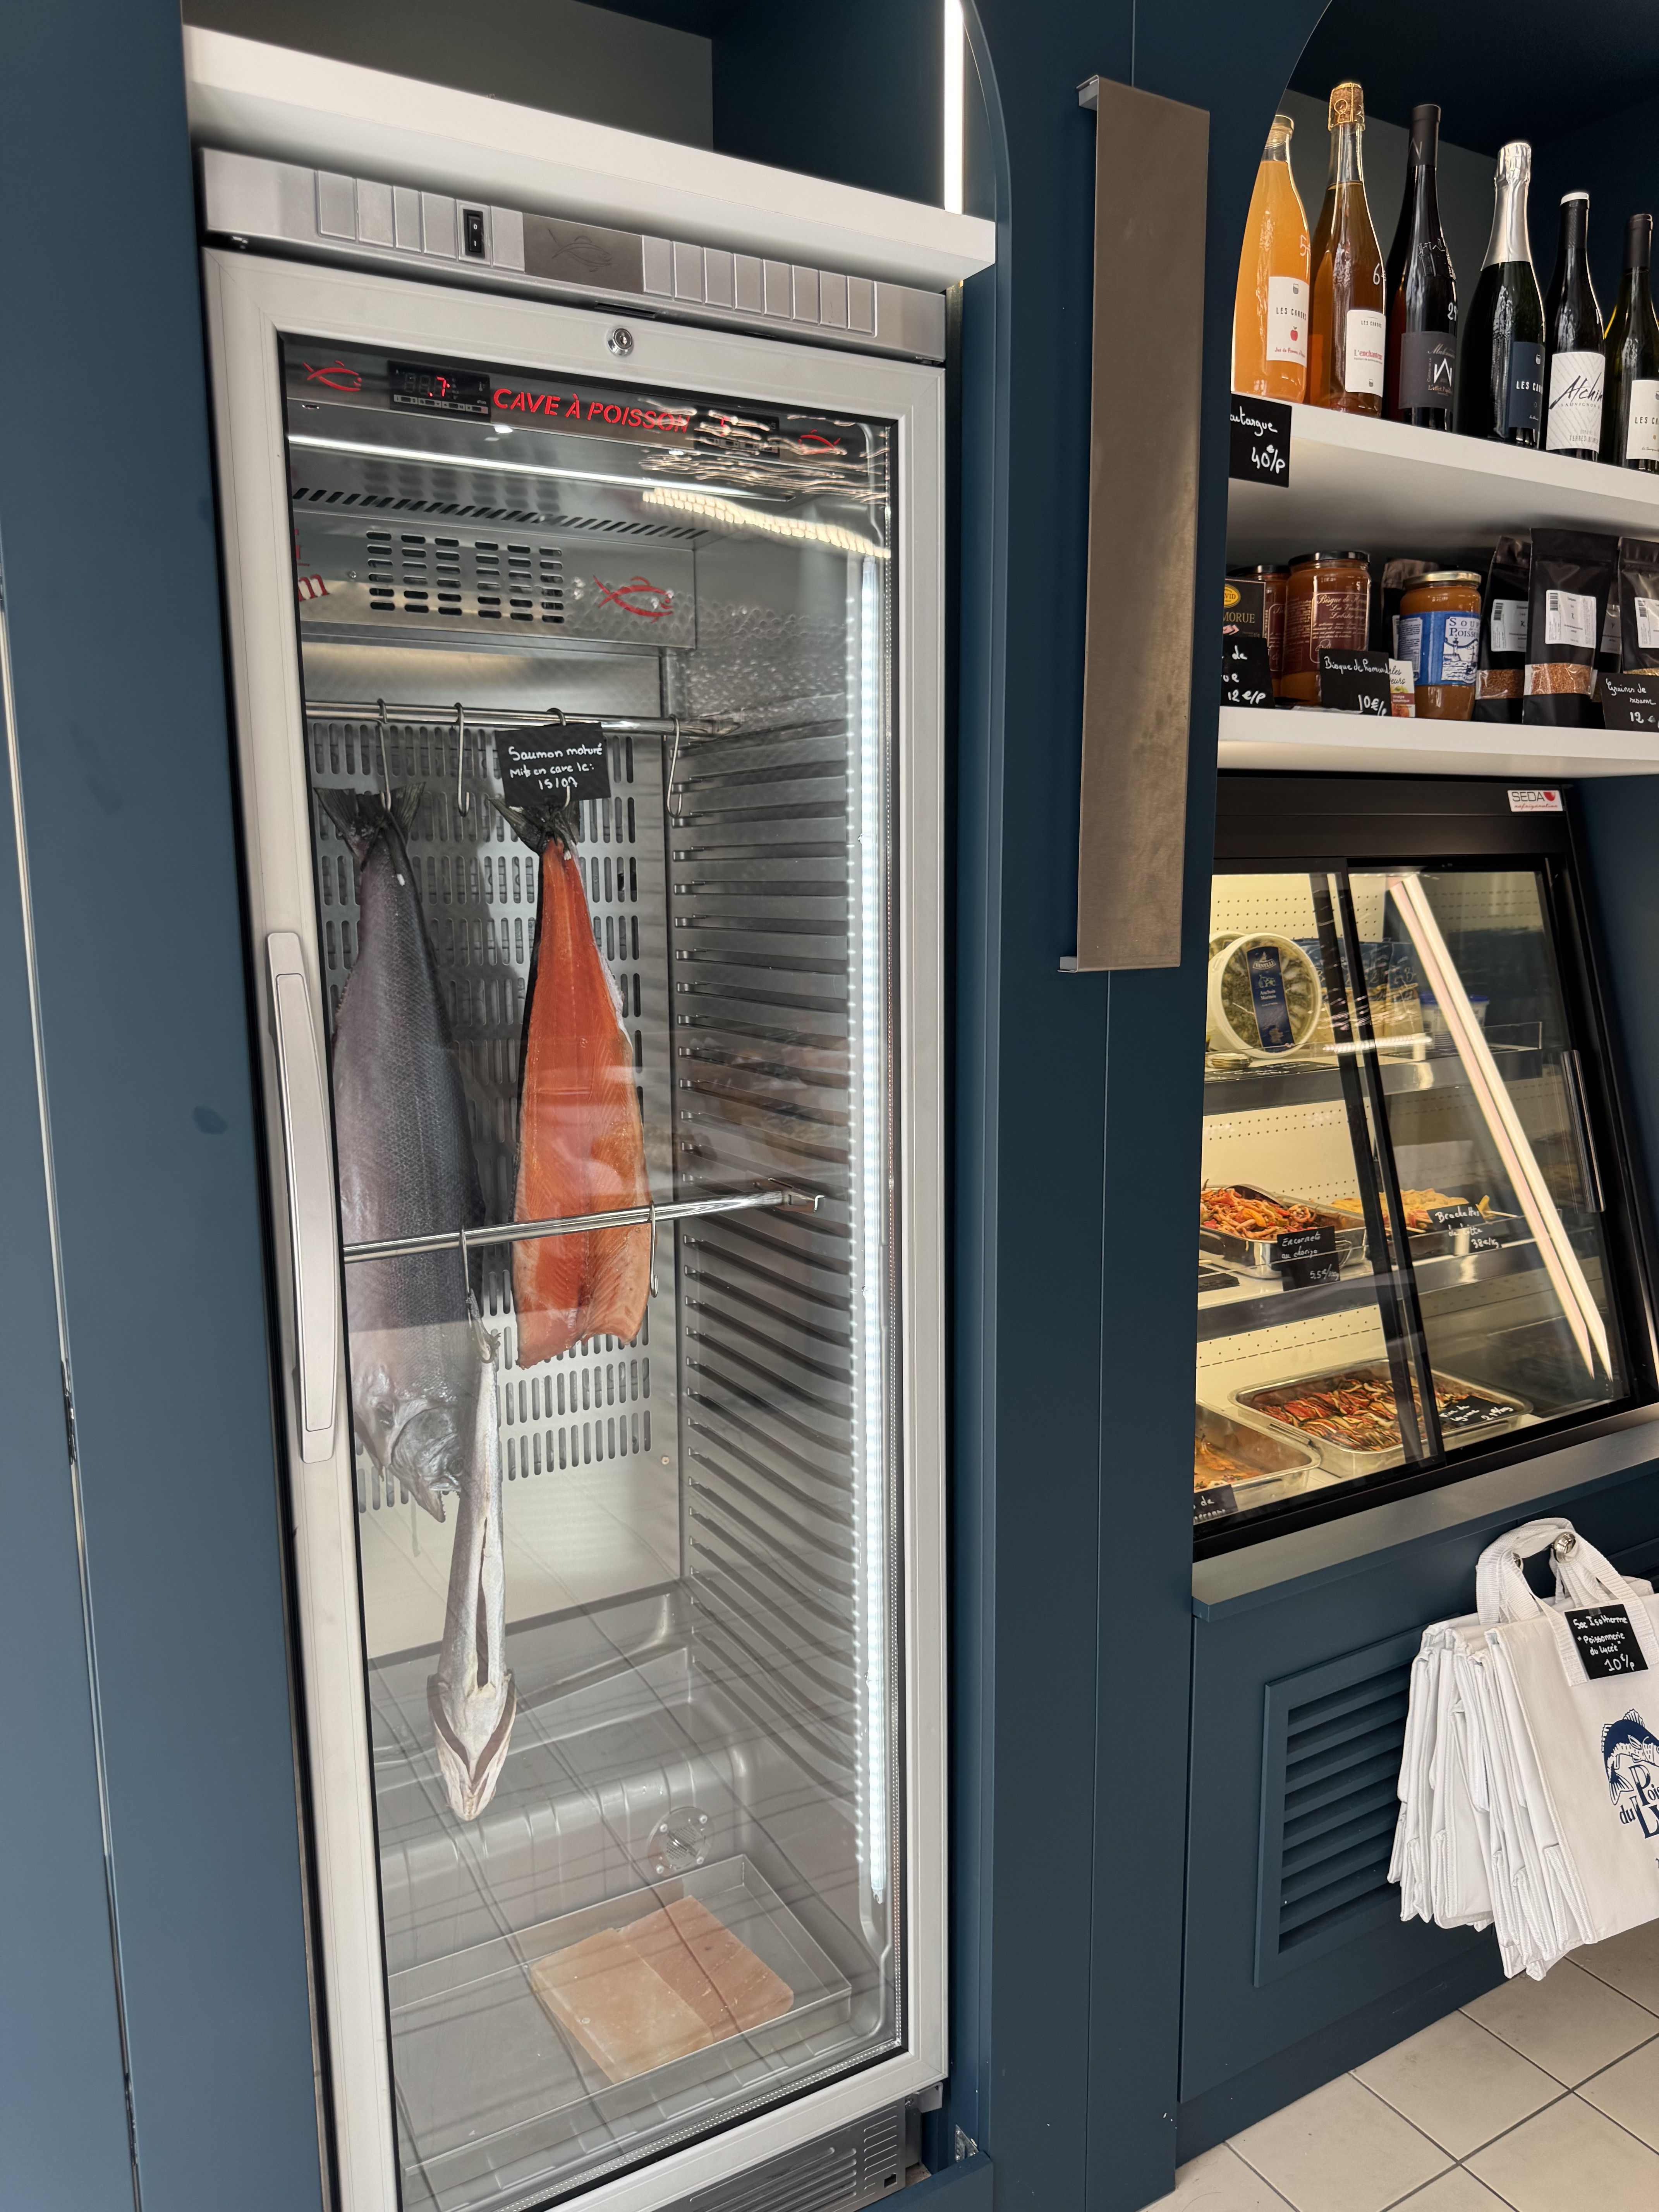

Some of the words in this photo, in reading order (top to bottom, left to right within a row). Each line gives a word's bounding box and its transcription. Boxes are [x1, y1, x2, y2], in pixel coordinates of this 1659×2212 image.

[1516, 381, 1530, 390] LES
[493, 388, 561, 416] CAVE
[565, 393, 580, 419] À
[587, 402, 690, 434] POISSON
[1317, 594, 1342, 607] Bisque
[1449, 617, 1479, 629] SOUP
[1231, 645, 1248, 660] de
[1324, 656, 1353, 675] Bisque
[1353, 659, 1363, 672] de
[1637, 683, 1647, 694] de
[508, 745, 563, 761] Saumon
[533, 767, 547, 776] en
[550, 765, 574, 775] cave
[1511, 791, 1545, 802] SEDA
[1200, 1495, 1215, 1506] de
[1590, 1647, 1599, 1656] du
[1619, 1804, 1636, 1824] du
